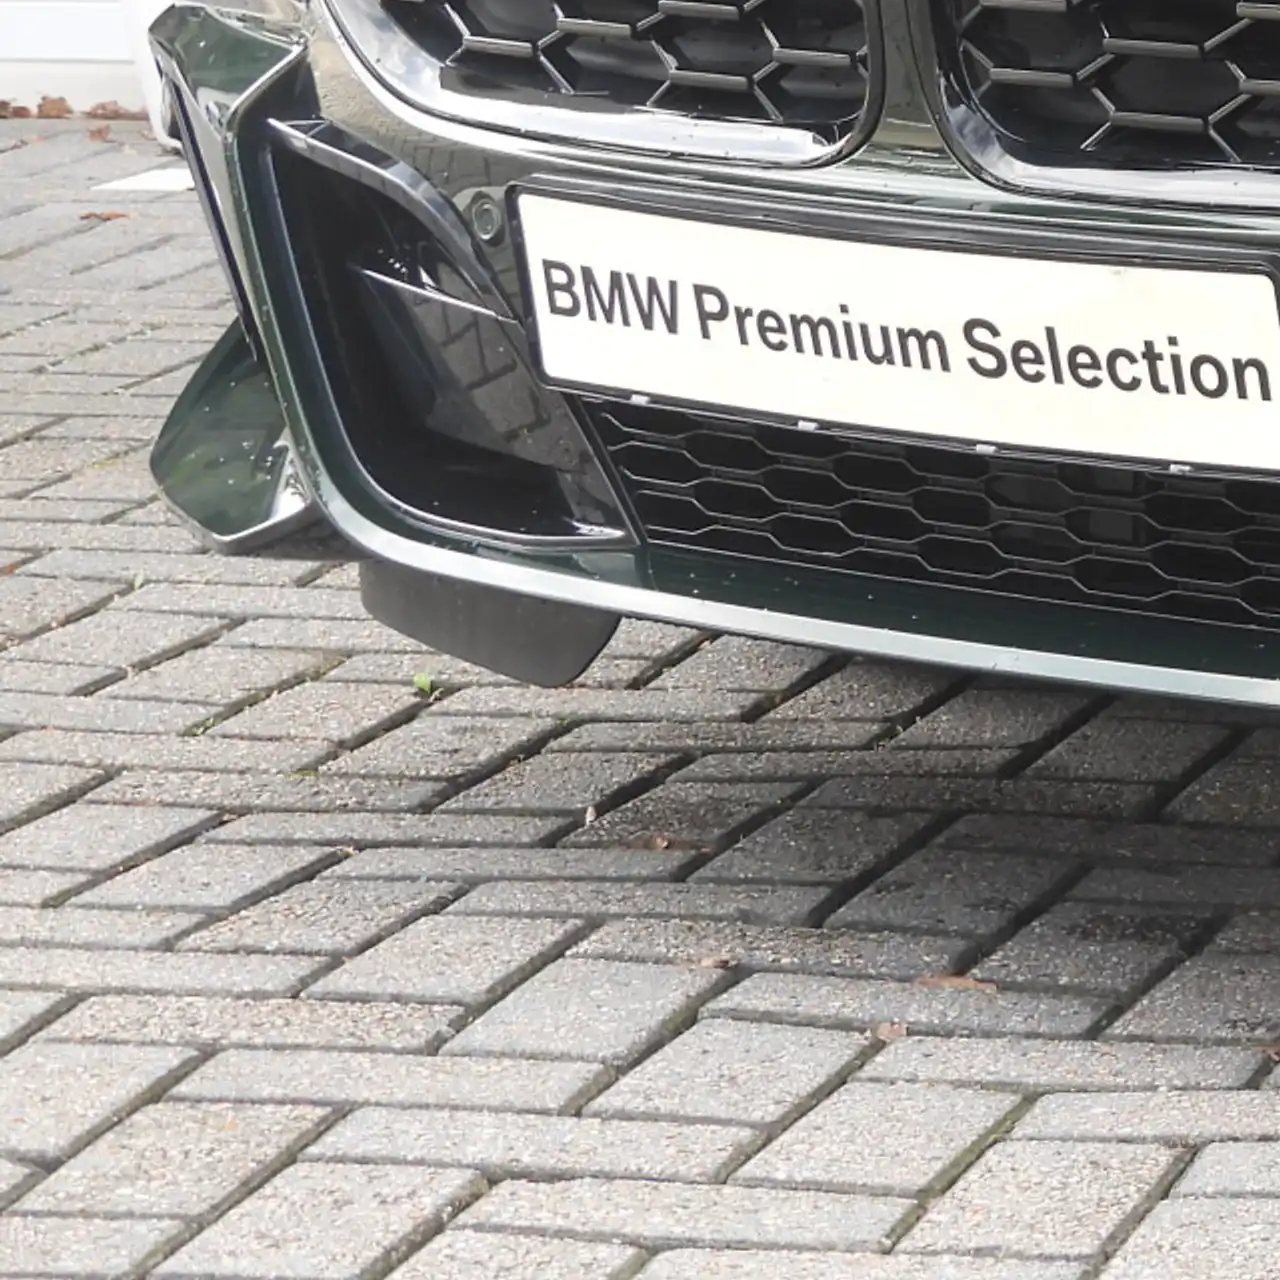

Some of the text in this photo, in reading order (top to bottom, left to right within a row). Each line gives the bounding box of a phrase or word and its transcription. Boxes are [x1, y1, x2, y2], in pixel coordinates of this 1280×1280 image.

[542, 259, 1272, 402] BMW Premium Selection
